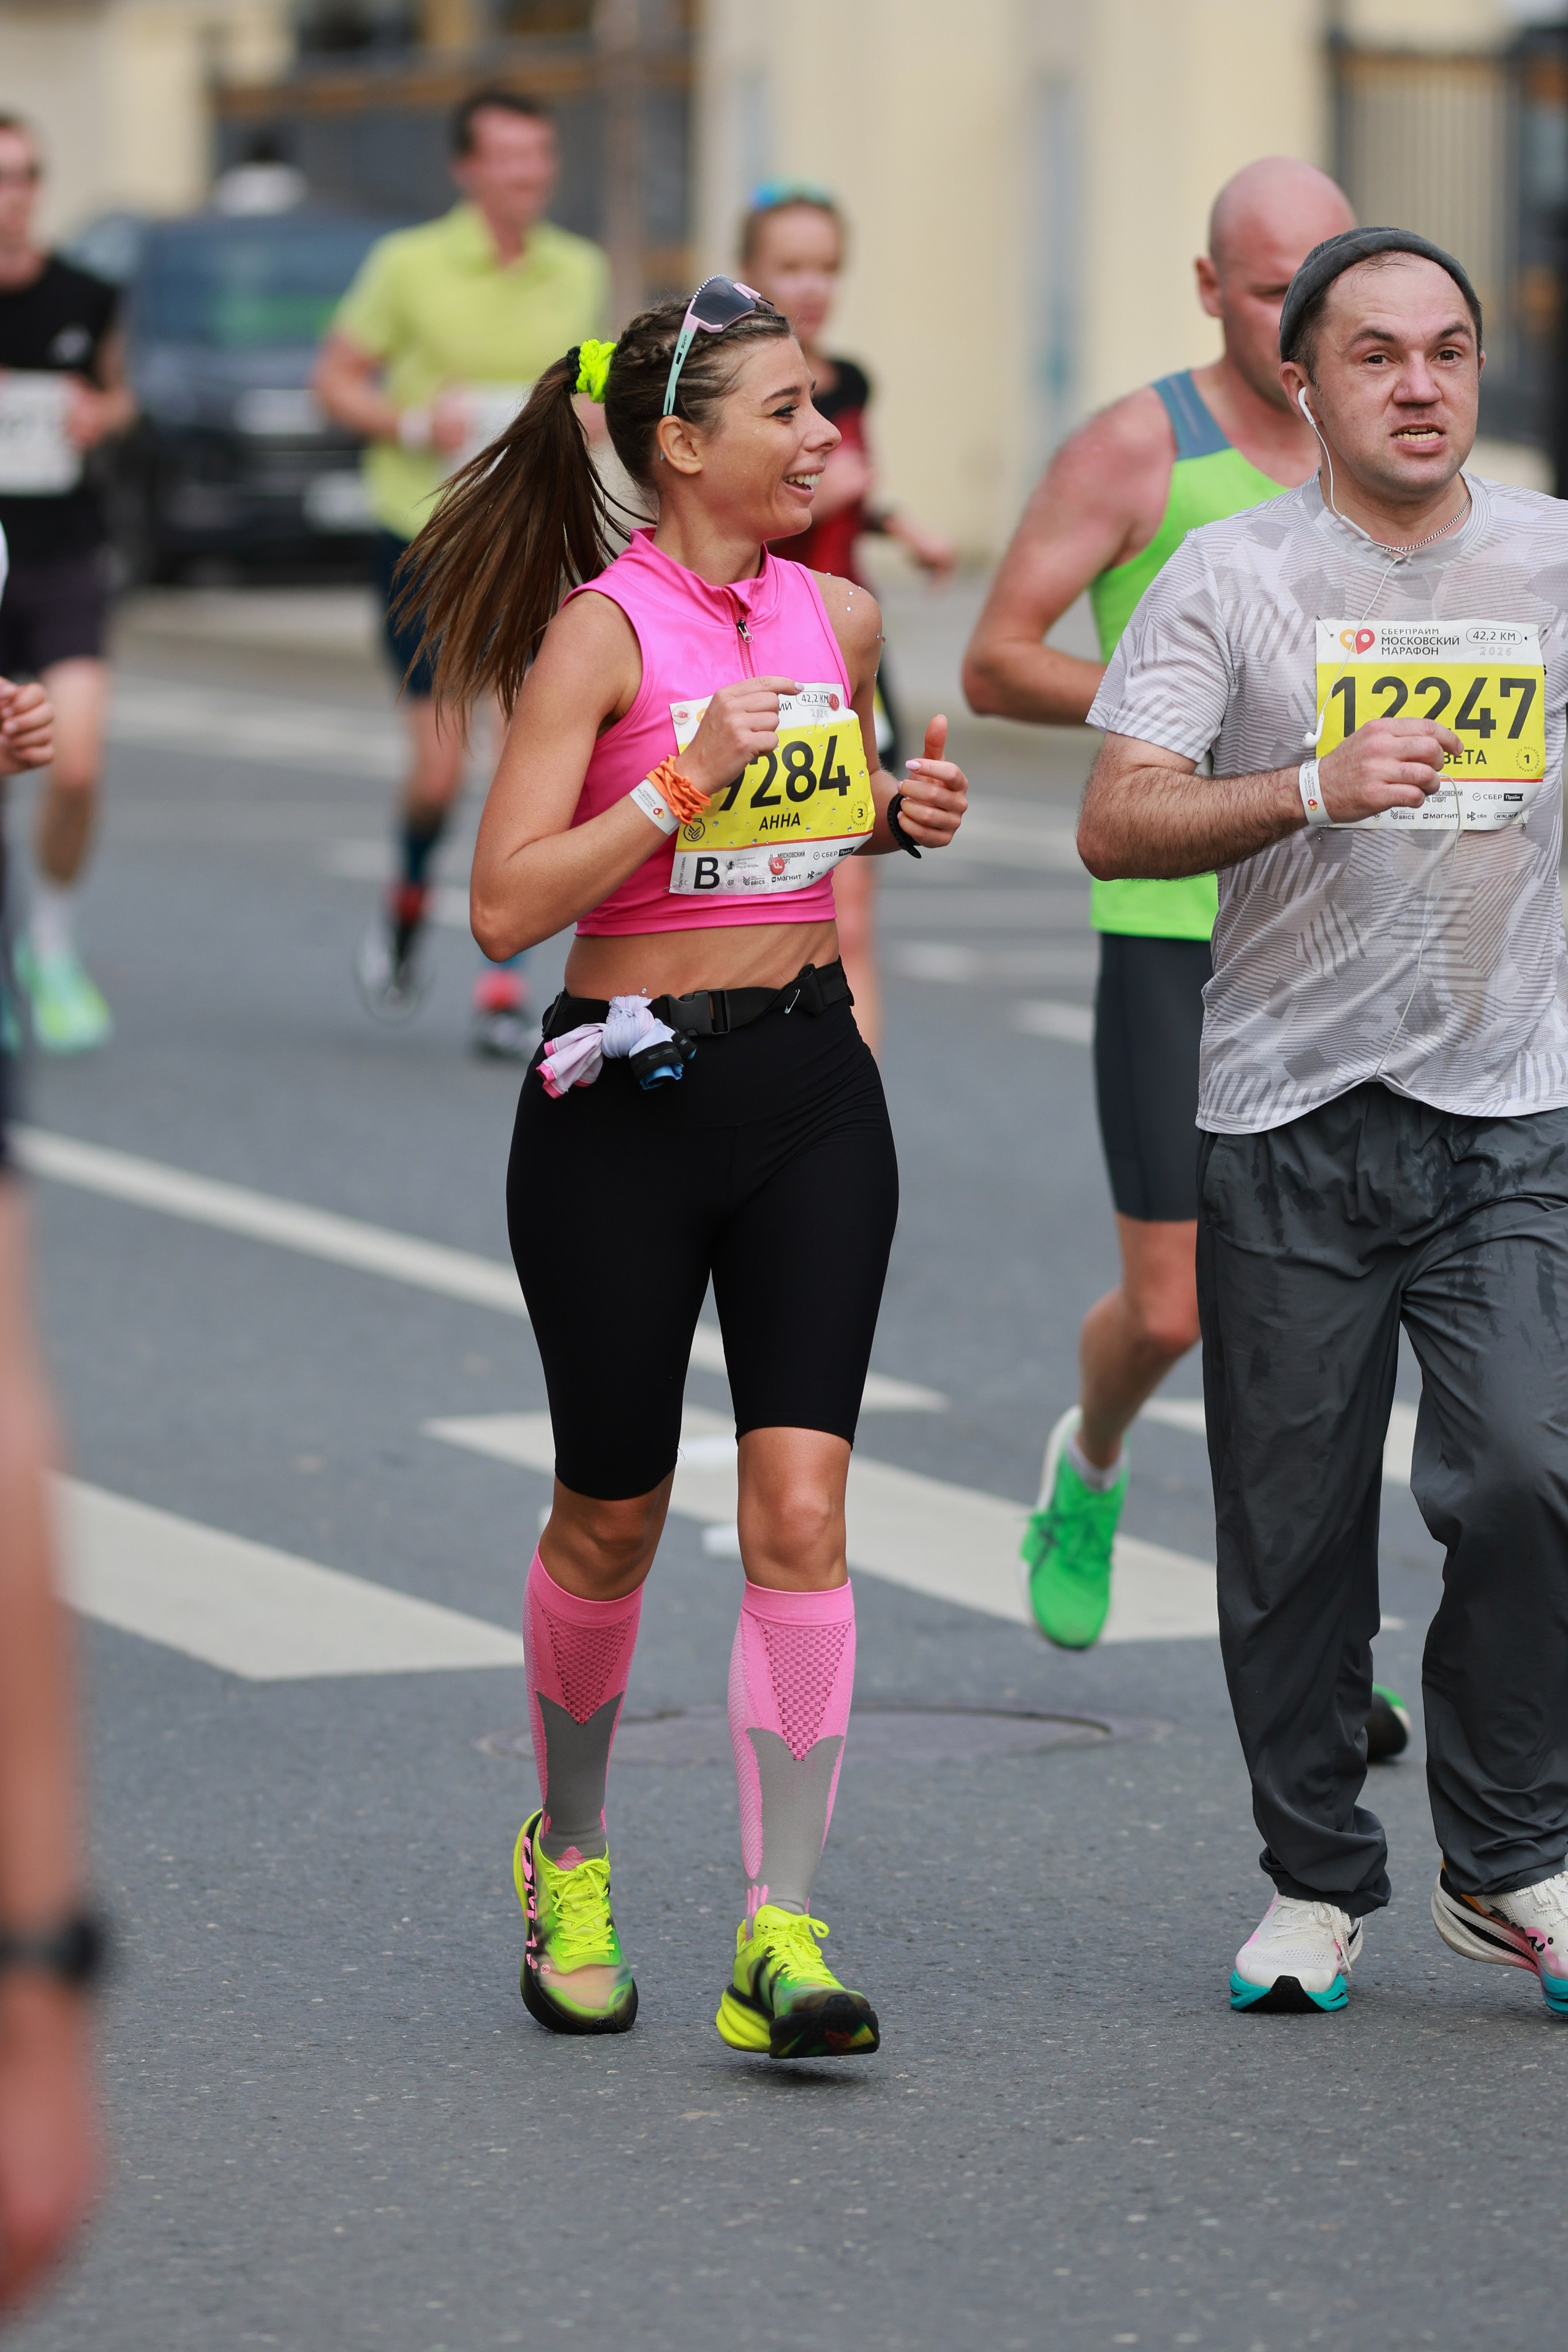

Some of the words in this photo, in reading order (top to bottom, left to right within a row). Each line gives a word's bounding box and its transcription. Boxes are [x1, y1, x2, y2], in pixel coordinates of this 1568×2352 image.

[1381, 635, 1460, 645] МОСКОВСКИЙ
[1472, 631, 1496, 641] 42,2
[1500, 632, 1515, 641] КМ
[1480, 647, 1512, 656] 2026
[802, 694, 818, 704] 42,2
[1332, 676, 1536, 739] 12247
[1524, 754, 1529, 764] 1
[858, 808, 864, 818] 3
[759, 812, 801, 831] АННА
